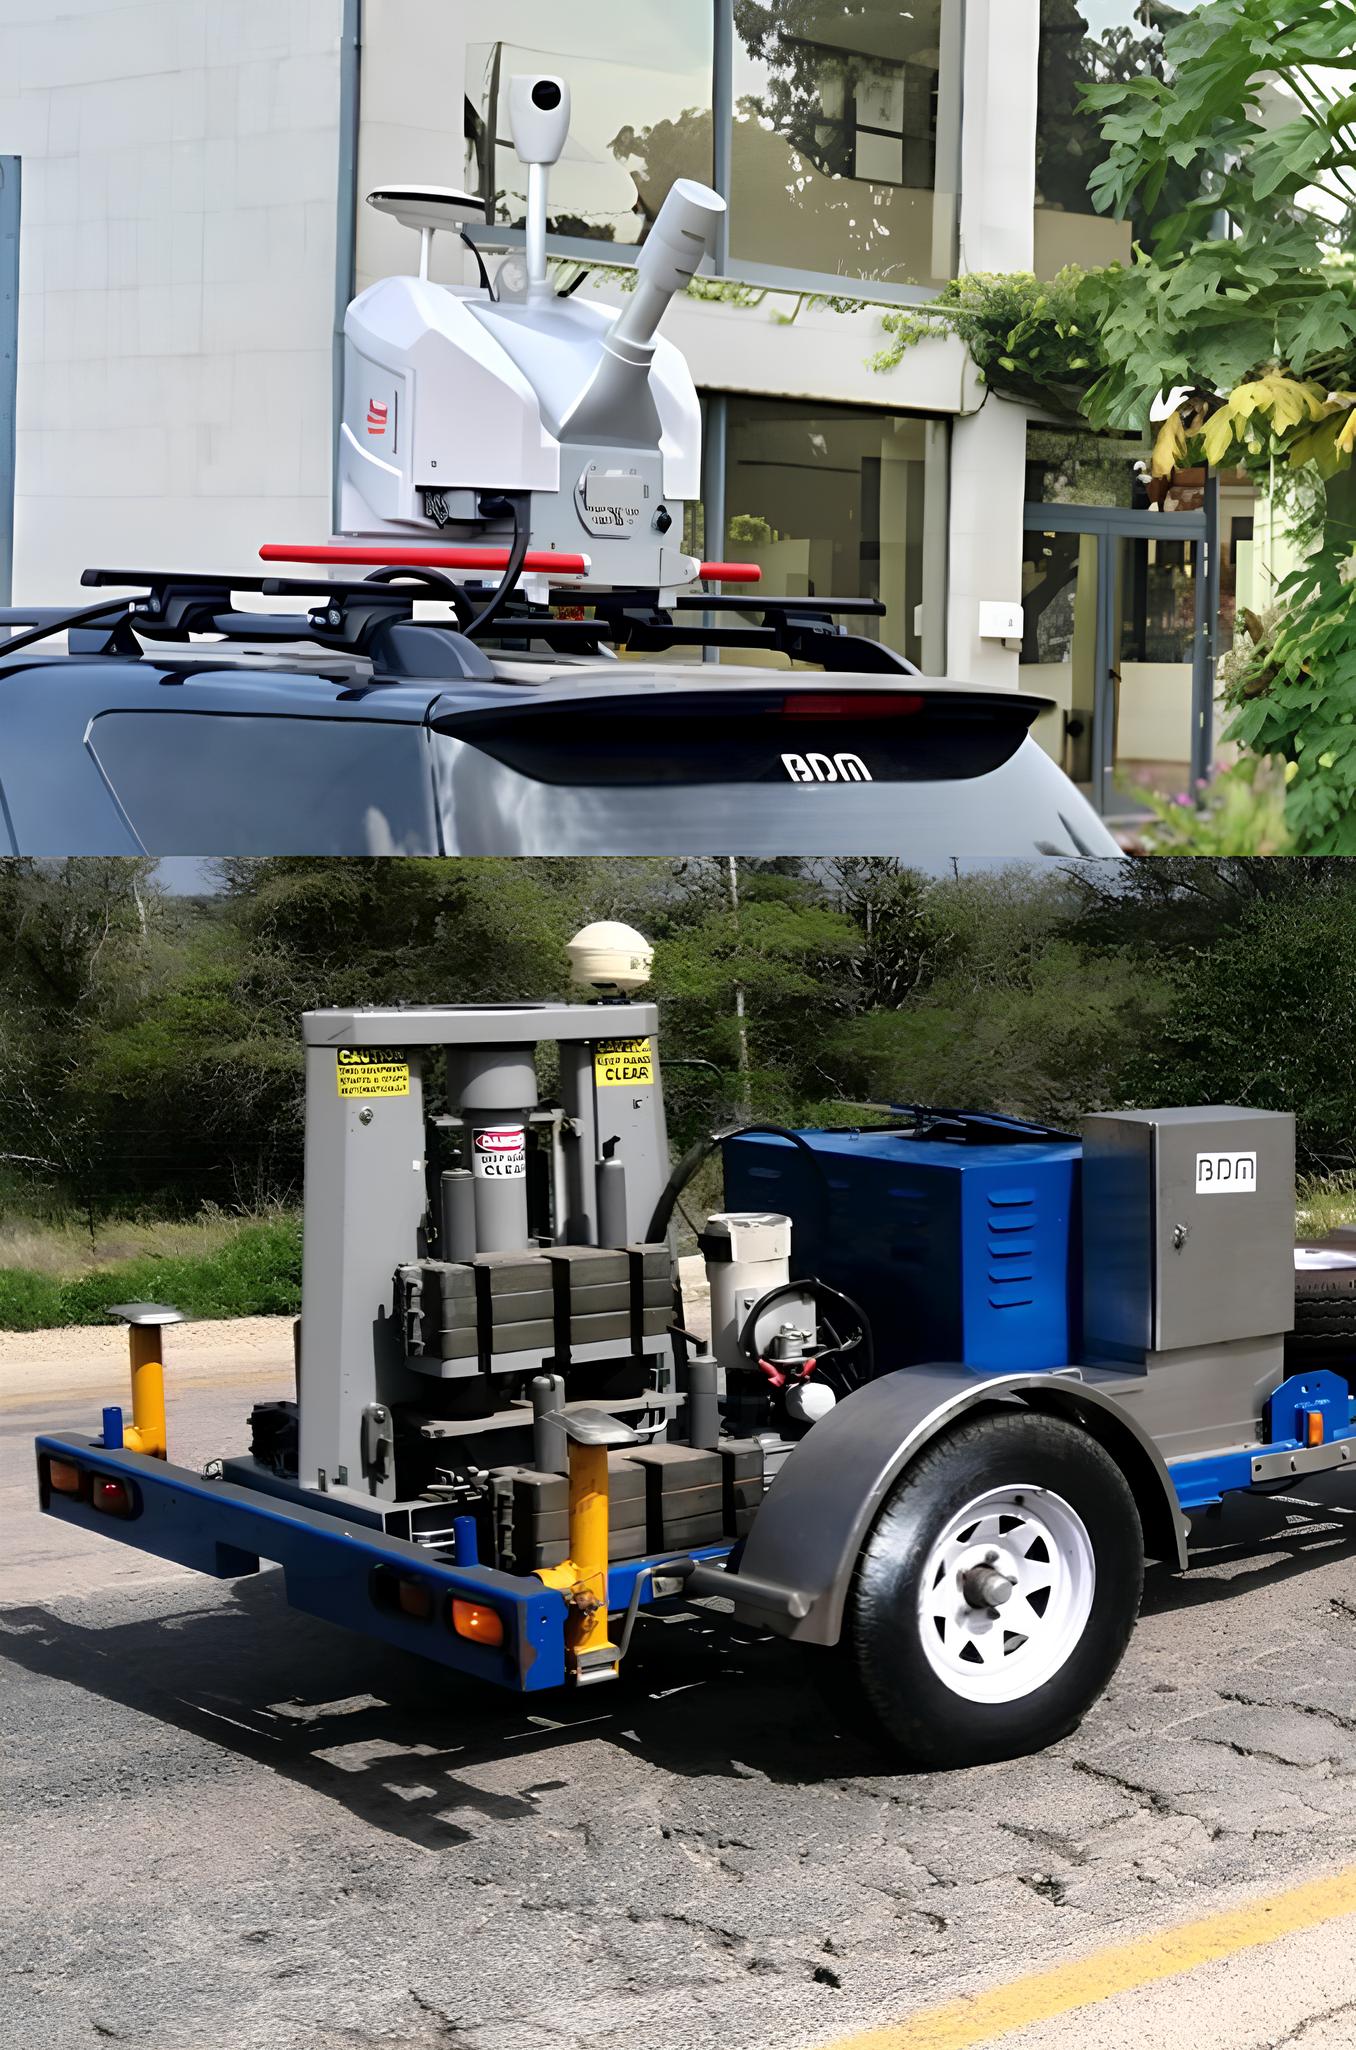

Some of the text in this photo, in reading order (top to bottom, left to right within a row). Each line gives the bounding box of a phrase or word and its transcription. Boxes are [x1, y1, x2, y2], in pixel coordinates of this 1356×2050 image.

[781, 752, 873, 782] BDM
[597, 1038, 652, 1053] CAUT
[339, 1049, 405, 1064] CAUTION
[606, 1067, 648, 1080] CLEAR
[1198, 1158, 1254, 1181] BDM
